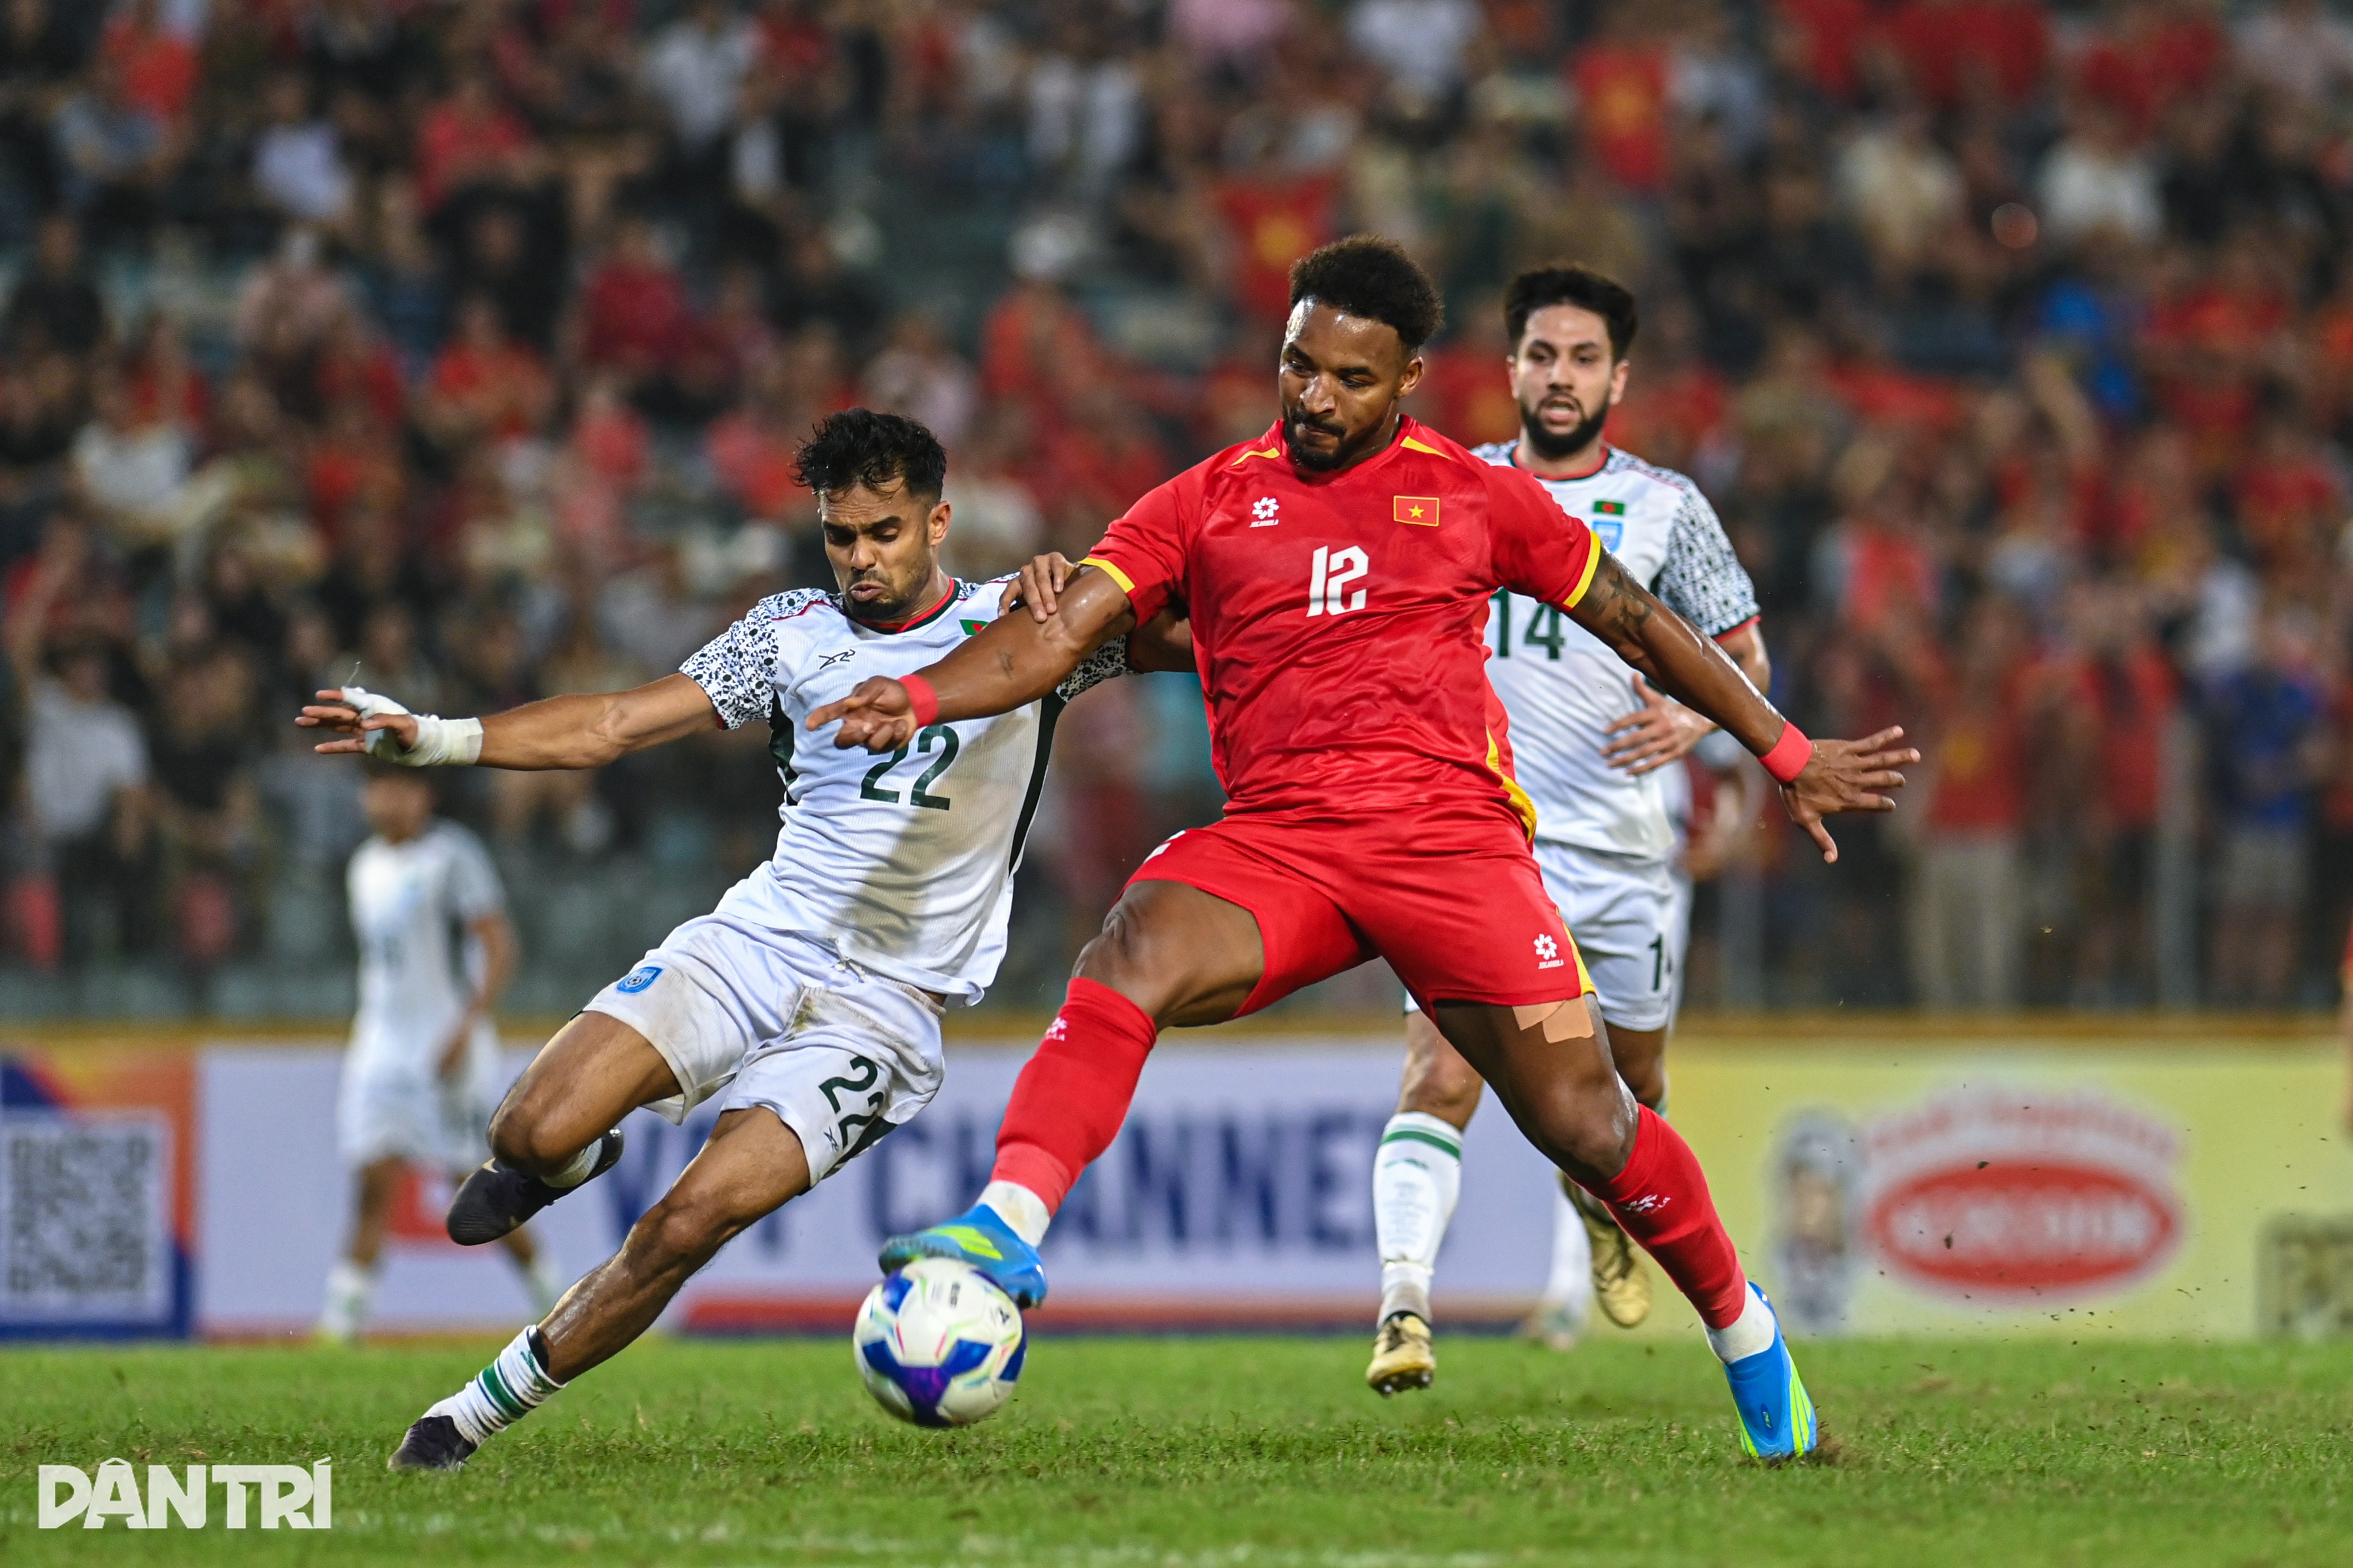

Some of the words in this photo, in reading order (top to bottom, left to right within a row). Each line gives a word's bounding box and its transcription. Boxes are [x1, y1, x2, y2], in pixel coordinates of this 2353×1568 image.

[1306, 545, 1369, 617] 12
[1489, 586, 1566, 660] 14
[860, 725, 959, 811] 22
[1648, 932, 1672, 991] 1
[819, 1056, 884, 1149] 22
